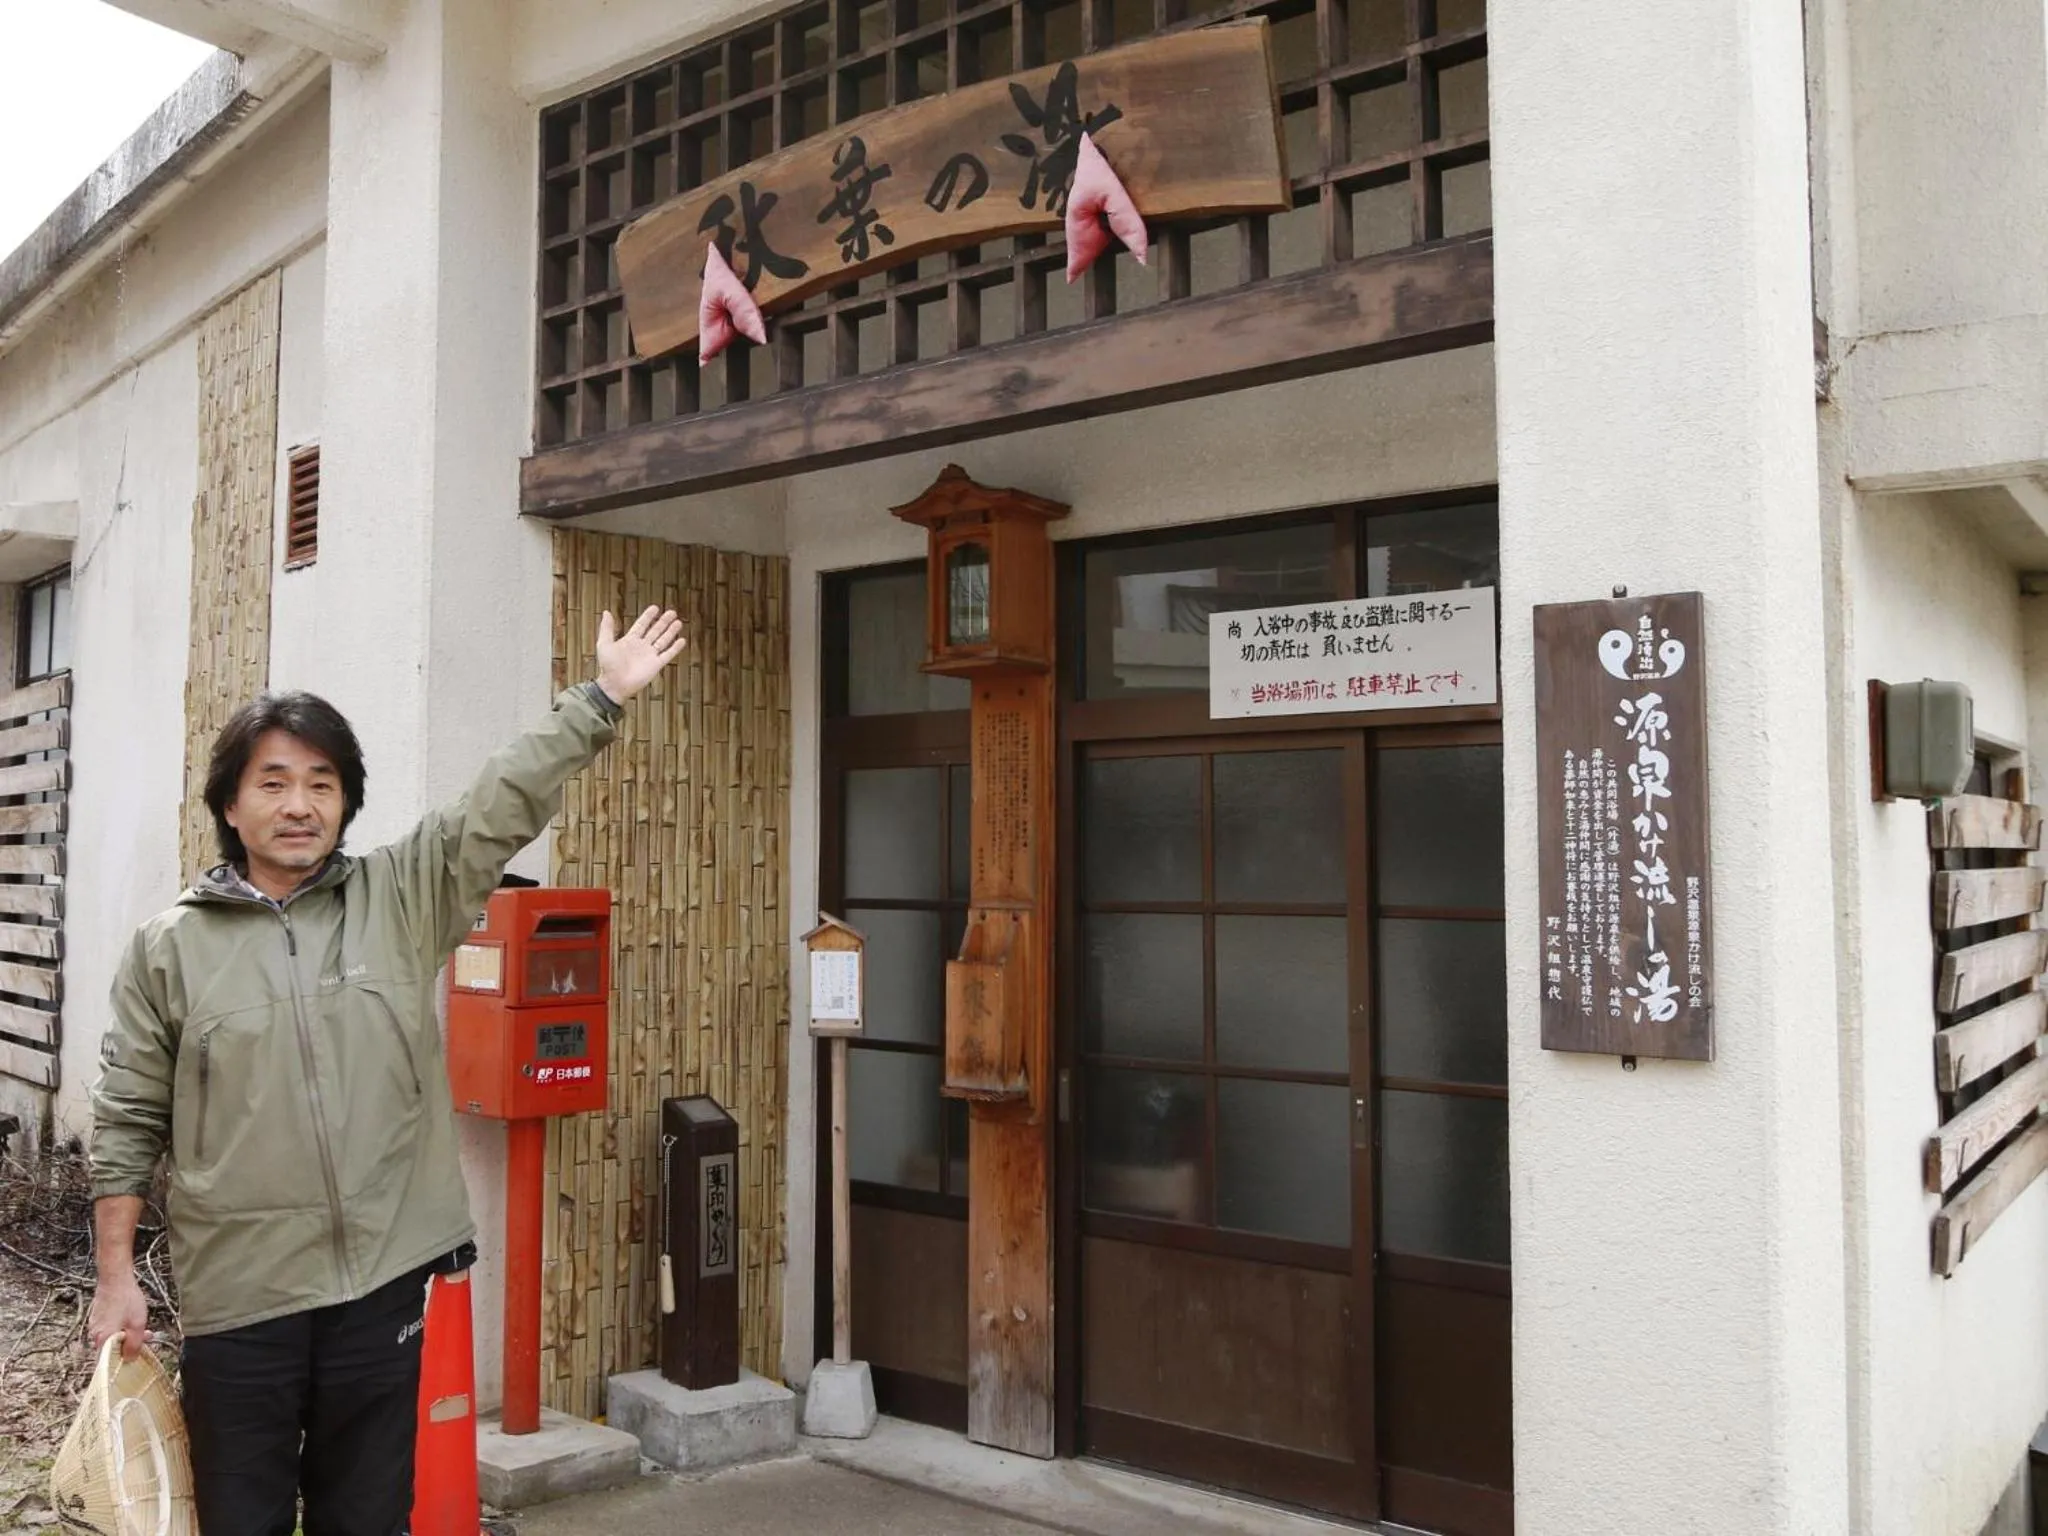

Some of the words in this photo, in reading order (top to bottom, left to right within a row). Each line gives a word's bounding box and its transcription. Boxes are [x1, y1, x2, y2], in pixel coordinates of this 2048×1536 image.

[698, 61, 1123, 290] 秋葉の湯
[1227, 620, 1242, 639] 尚
[1241, 640, 1309, 662] 切の責任は
[1251, 682, 1337, 704] 当浴場前は
[1613, 692, 1681, 1024] 源泉かけ流しの湯
